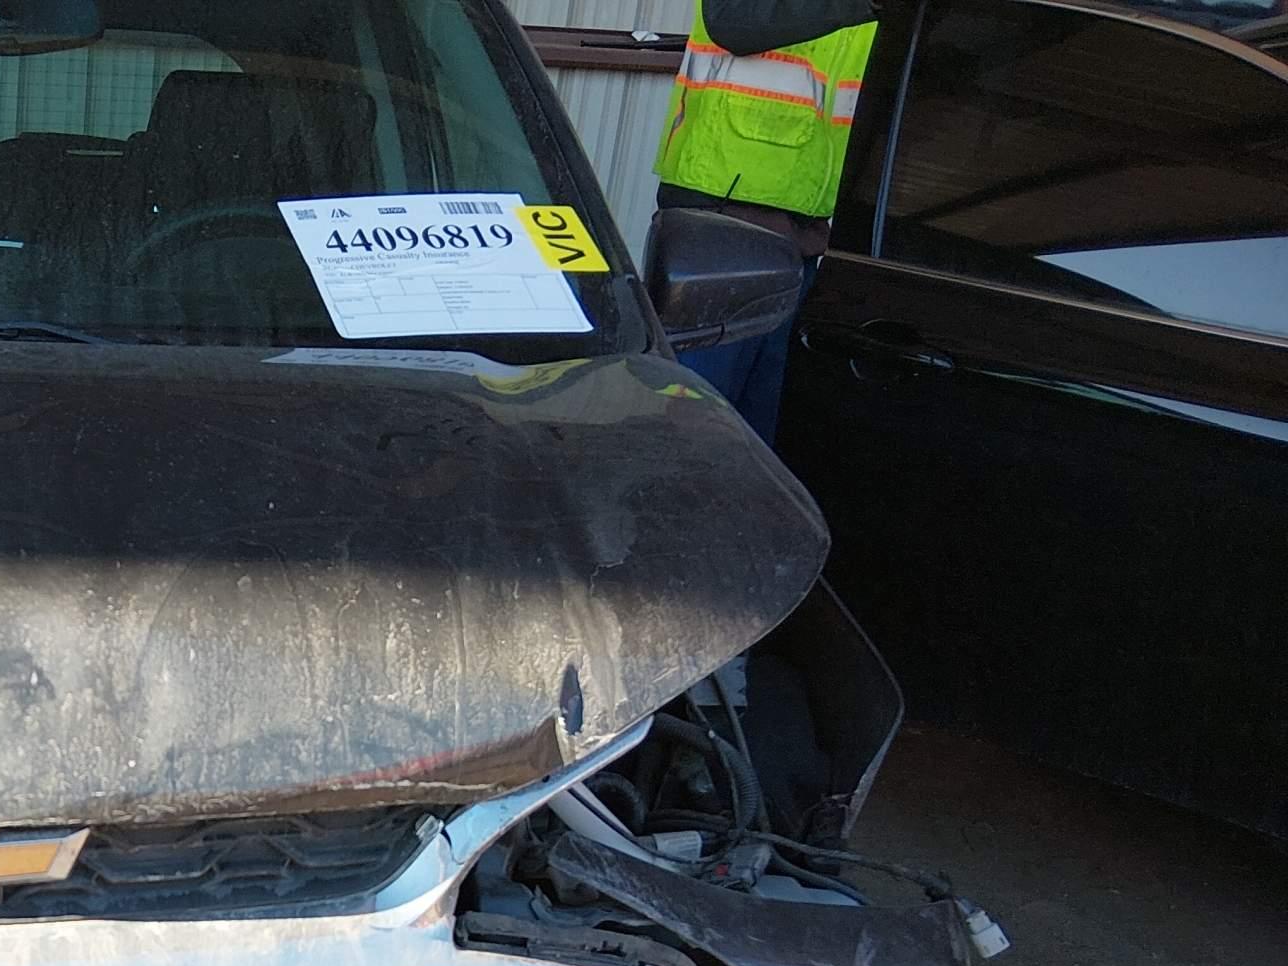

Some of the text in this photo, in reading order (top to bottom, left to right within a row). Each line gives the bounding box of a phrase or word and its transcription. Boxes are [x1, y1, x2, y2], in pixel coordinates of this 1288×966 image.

[325, 223, 513, 253] 44096819
[531, 211, 586, 264] VIC
[316, 251, 470, 265] Progressive Casualty Insurance
